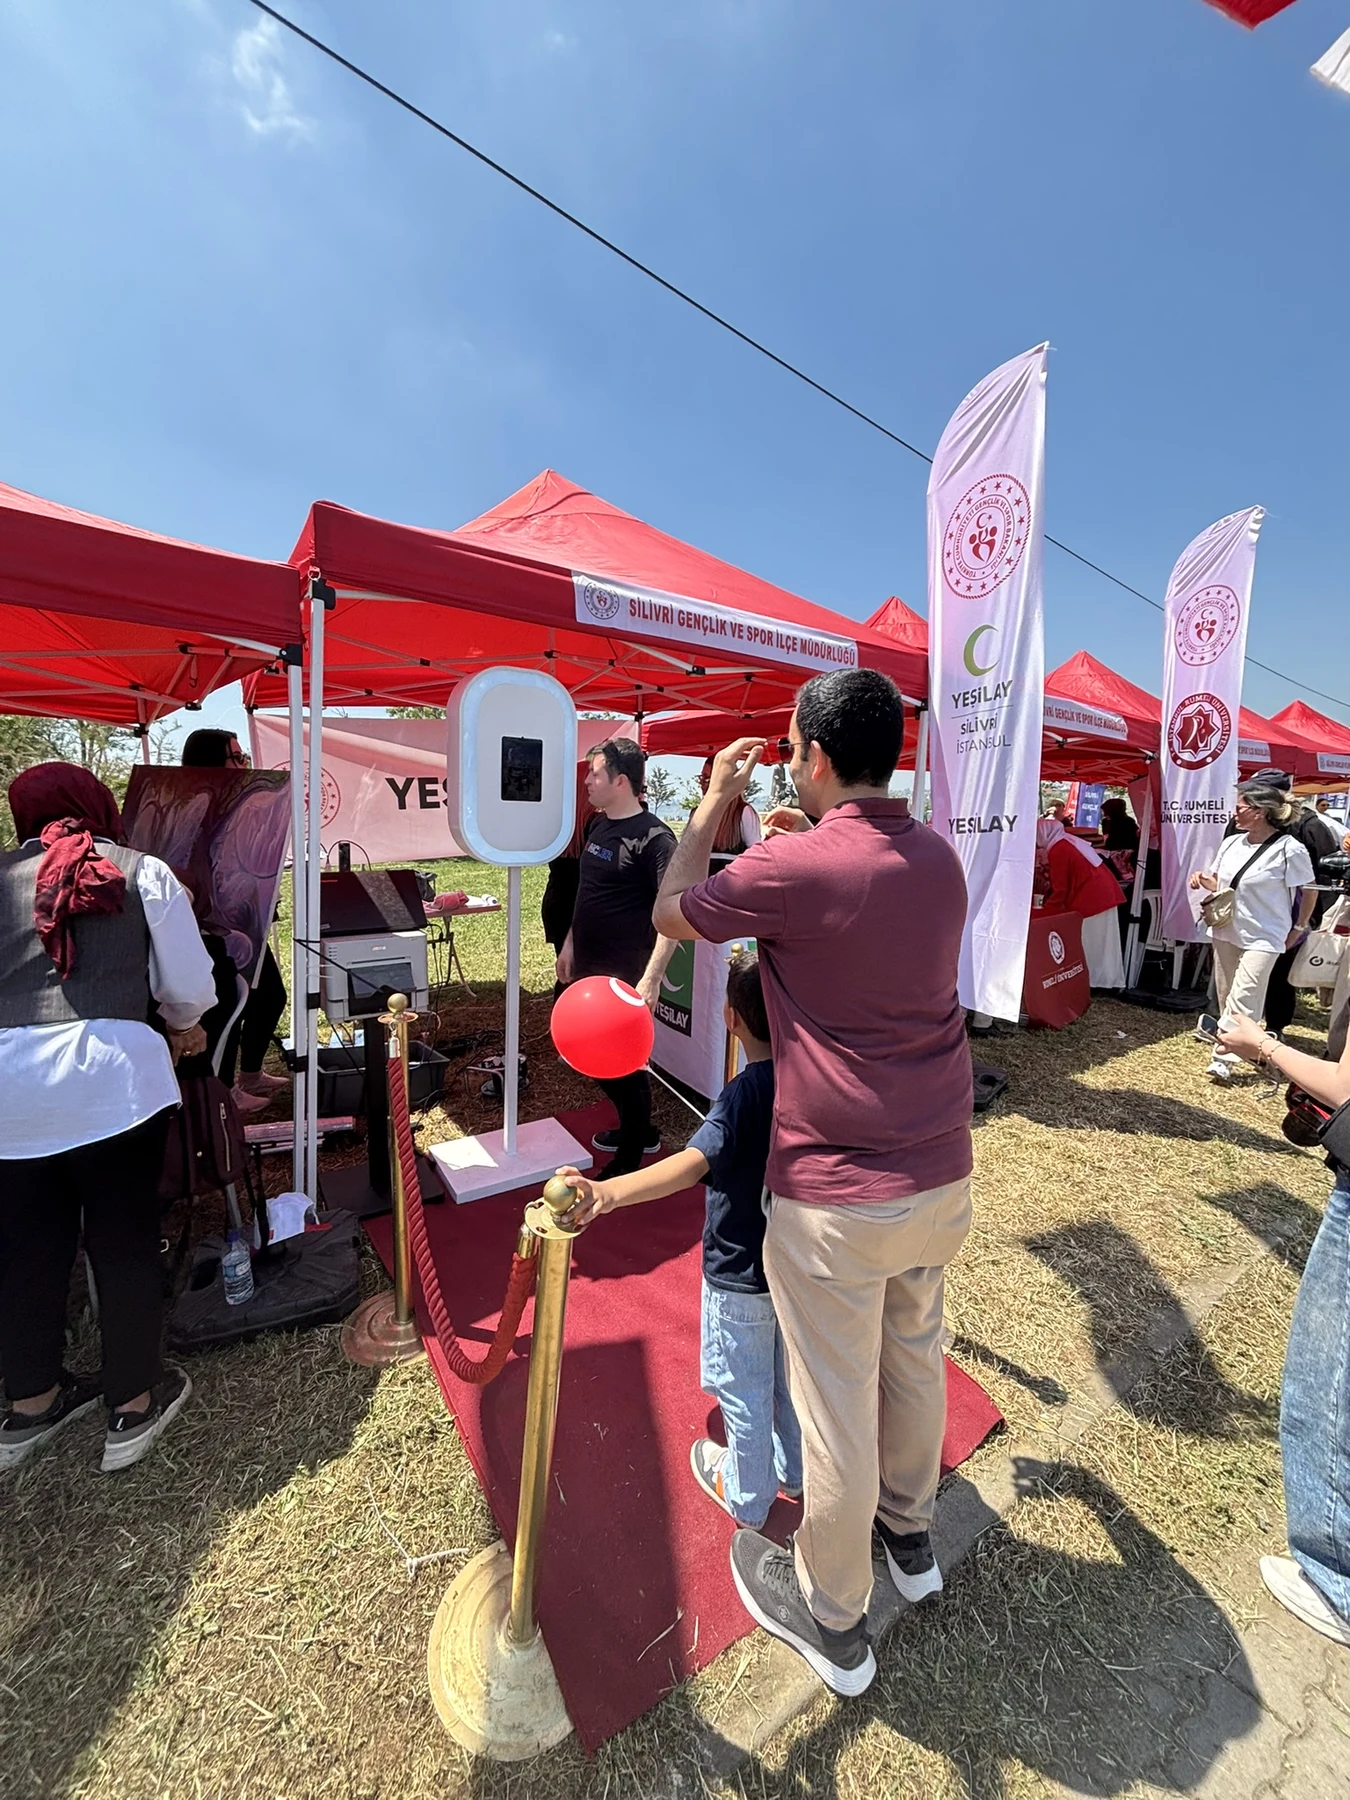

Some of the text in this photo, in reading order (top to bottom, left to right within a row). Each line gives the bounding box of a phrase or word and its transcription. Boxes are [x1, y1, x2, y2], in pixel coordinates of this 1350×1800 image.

[628, 597, 674, 625] SİLİVRİ
[677, 609, 727, 636] GENÇLİK
[730, 622, 744, 639] VE
[747, 625, 774, 646] SPOR
[775, 629, 798, 655] İLÇE
[799, 637, 856, 666] MÜDÜRLÜĞÜ
[951, 680, 1014, 710] YEŞİLAY
[960, 713, 999, 736] SİLİVRİ
[948, 813, 1018, 838] YEŞİLAY
